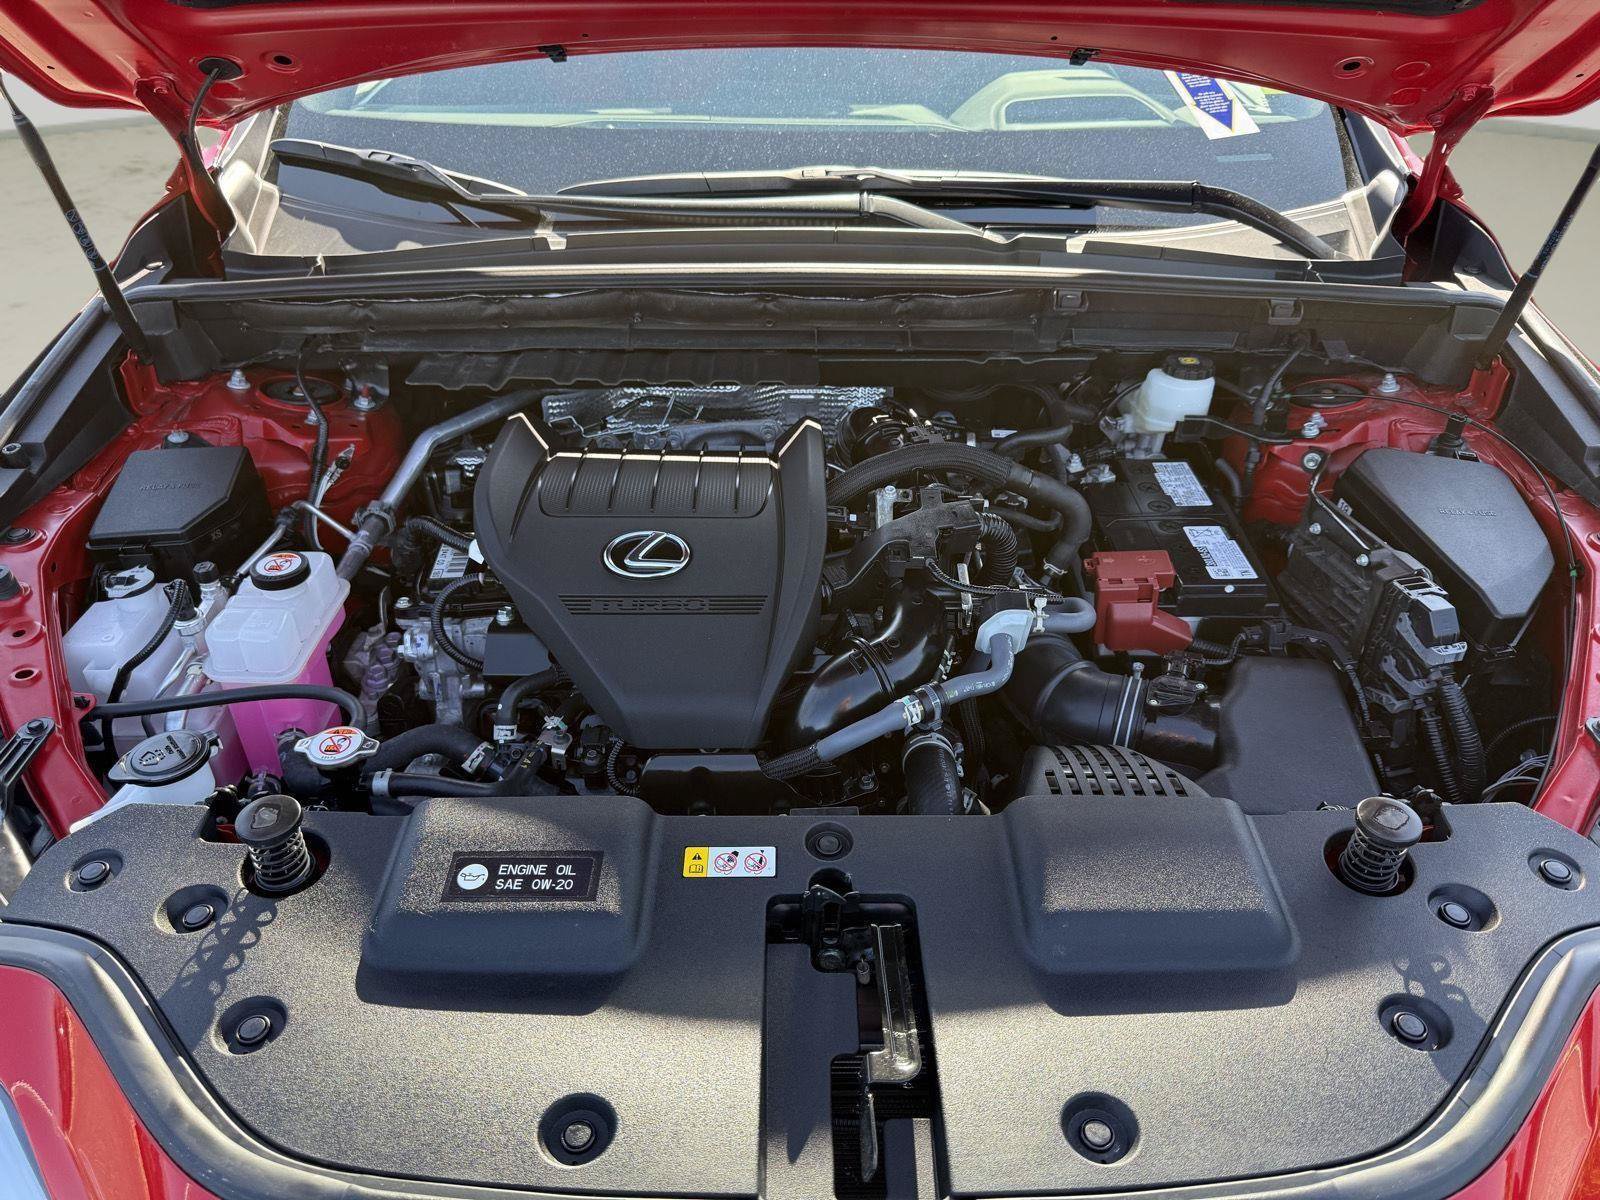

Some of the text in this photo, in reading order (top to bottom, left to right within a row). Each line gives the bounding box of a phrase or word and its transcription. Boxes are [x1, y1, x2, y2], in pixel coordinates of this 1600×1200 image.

[591, 599, 706, 612] TURBO
[498, 864, 576, 875] ENGINE OIL
[495, 879, 574, 890] SAE 0W-20
